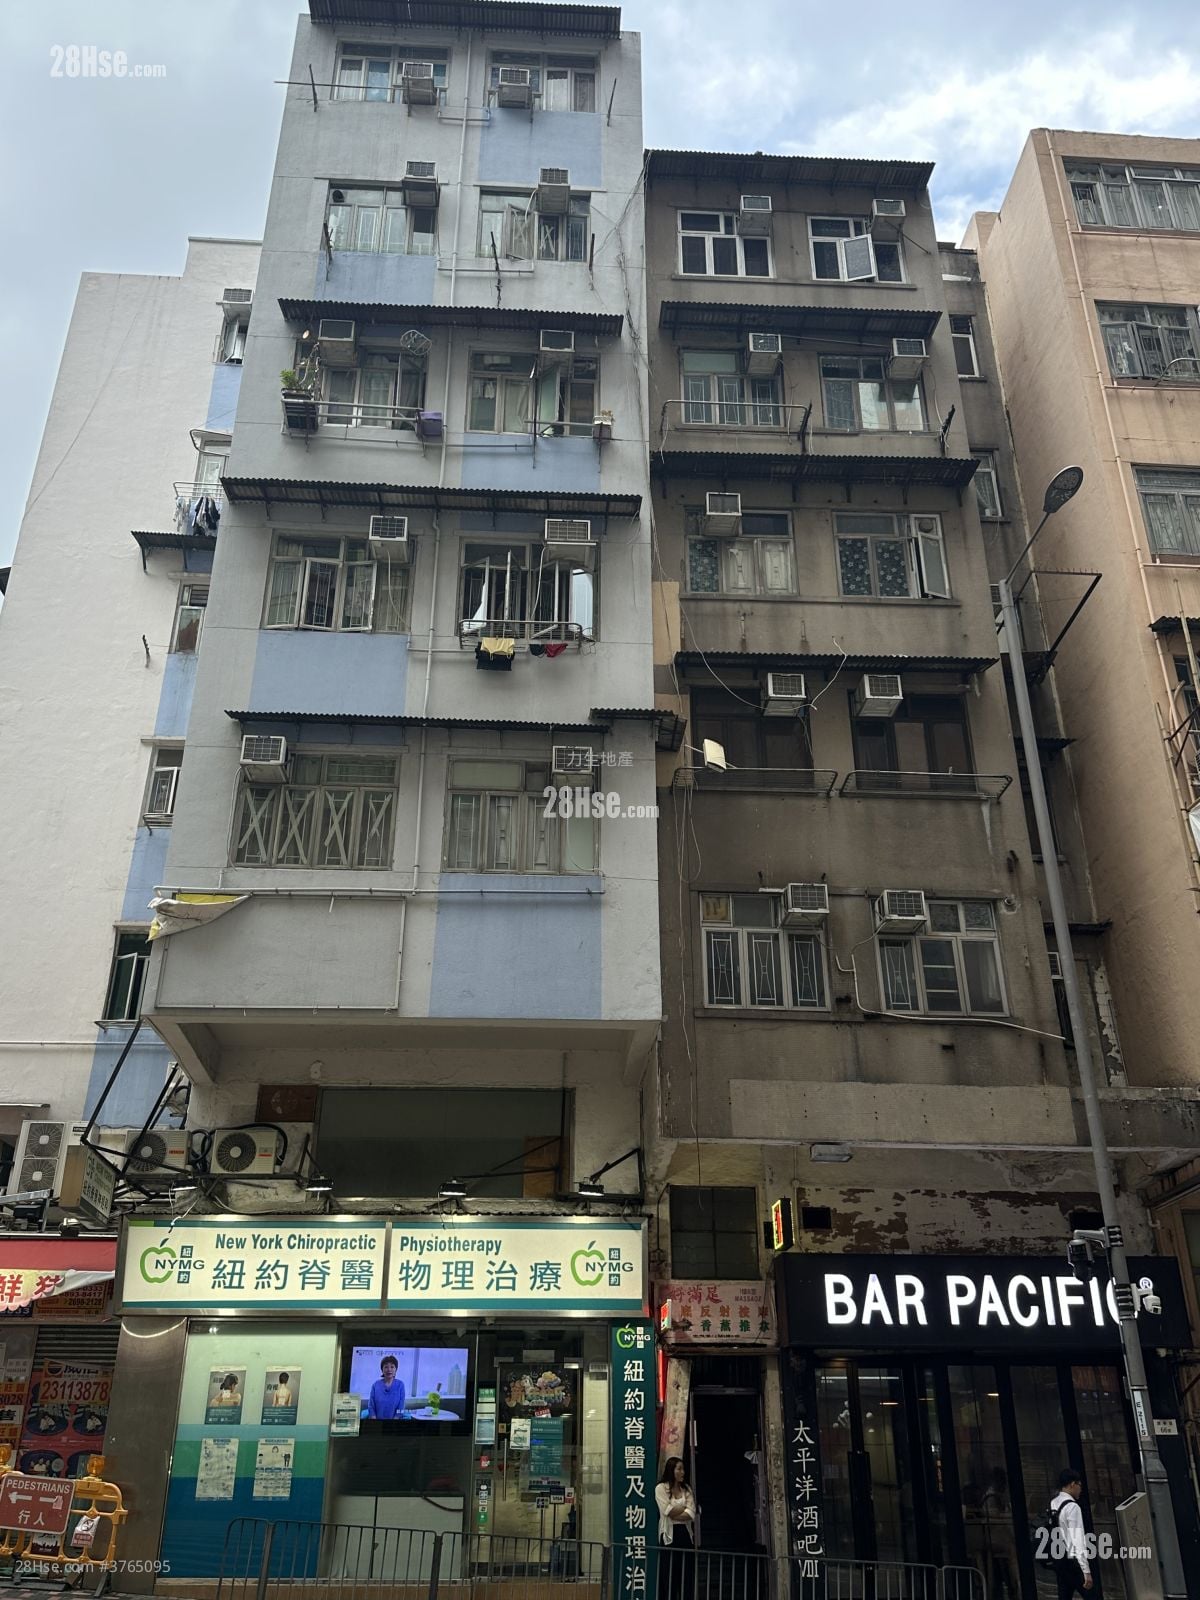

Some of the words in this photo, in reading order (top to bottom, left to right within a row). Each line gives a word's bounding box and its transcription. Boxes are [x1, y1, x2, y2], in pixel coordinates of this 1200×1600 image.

[215, 1233, 247, 1250] New
[251, 1233, 284, 1250] York
[287, 1233, 377, 1254] Chiropractic
[400, 1235, 502, 1255] Physiotherapy
[155, 1259, 205, 1270] NYMG
[585, 1262, 634, 1272] NYMG
[212, 1260, 374, 1291] 紐約脊醫
[398, 1259, 562, 1292] 物理治療
[823, 1273, 928, 1326] BAR
[40, 1380, 109, 1401] 23113878
[6, 1479, 71, 1494] PEDESTRIANS
[623, 1359, 647, 1600] 紐約脊醫及物理治
[18, 1509, 45, 1526] 行人
